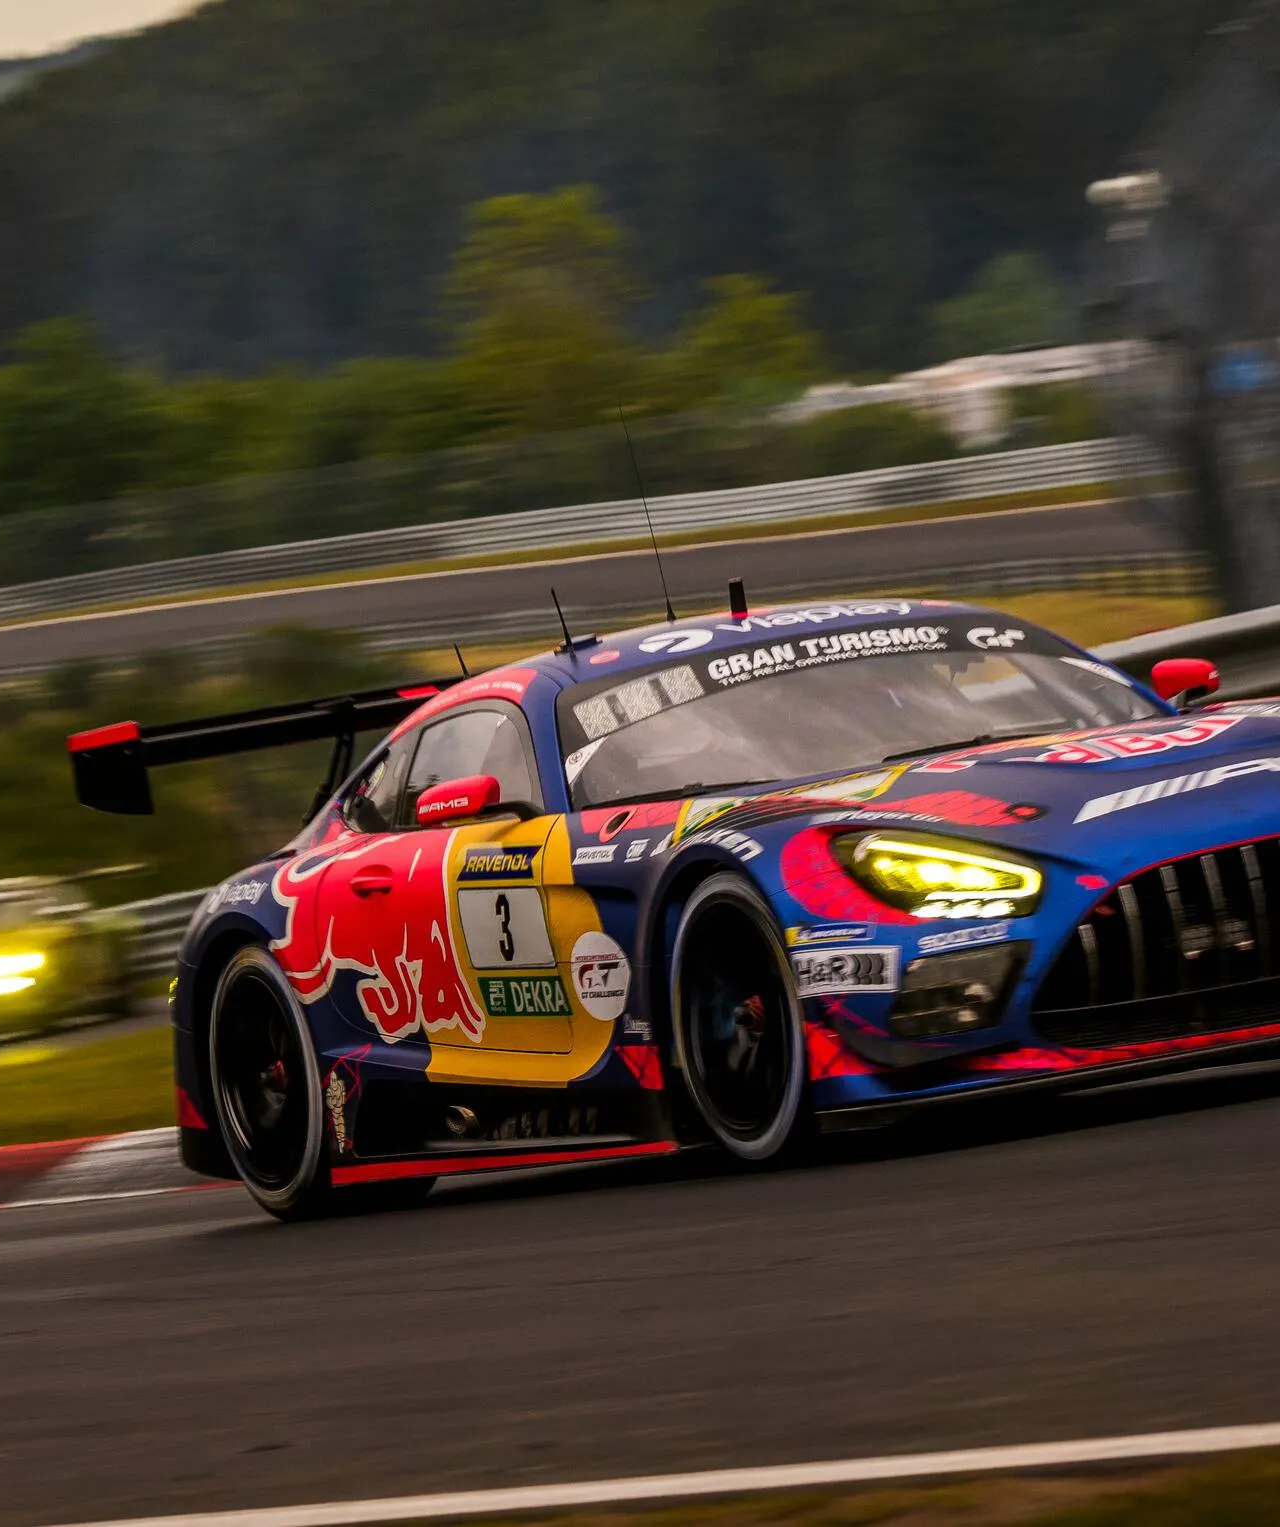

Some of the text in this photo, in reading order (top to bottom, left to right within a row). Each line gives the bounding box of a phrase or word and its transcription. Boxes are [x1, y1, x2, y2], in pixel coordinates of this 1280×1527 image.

[707, 626, 939, 681] GRAN TURISMO
[719, 671, 753, 686] THE
[753, 661, 795, 678] REAL
[795, 649, 859, 668] DRIVING
[428, 797, 469, 815] AMG
[465, 853, 529, 872] RAVENOL
[495, 894, 515, 962] 3
[509, 980, 569, 1012] DEKRA
